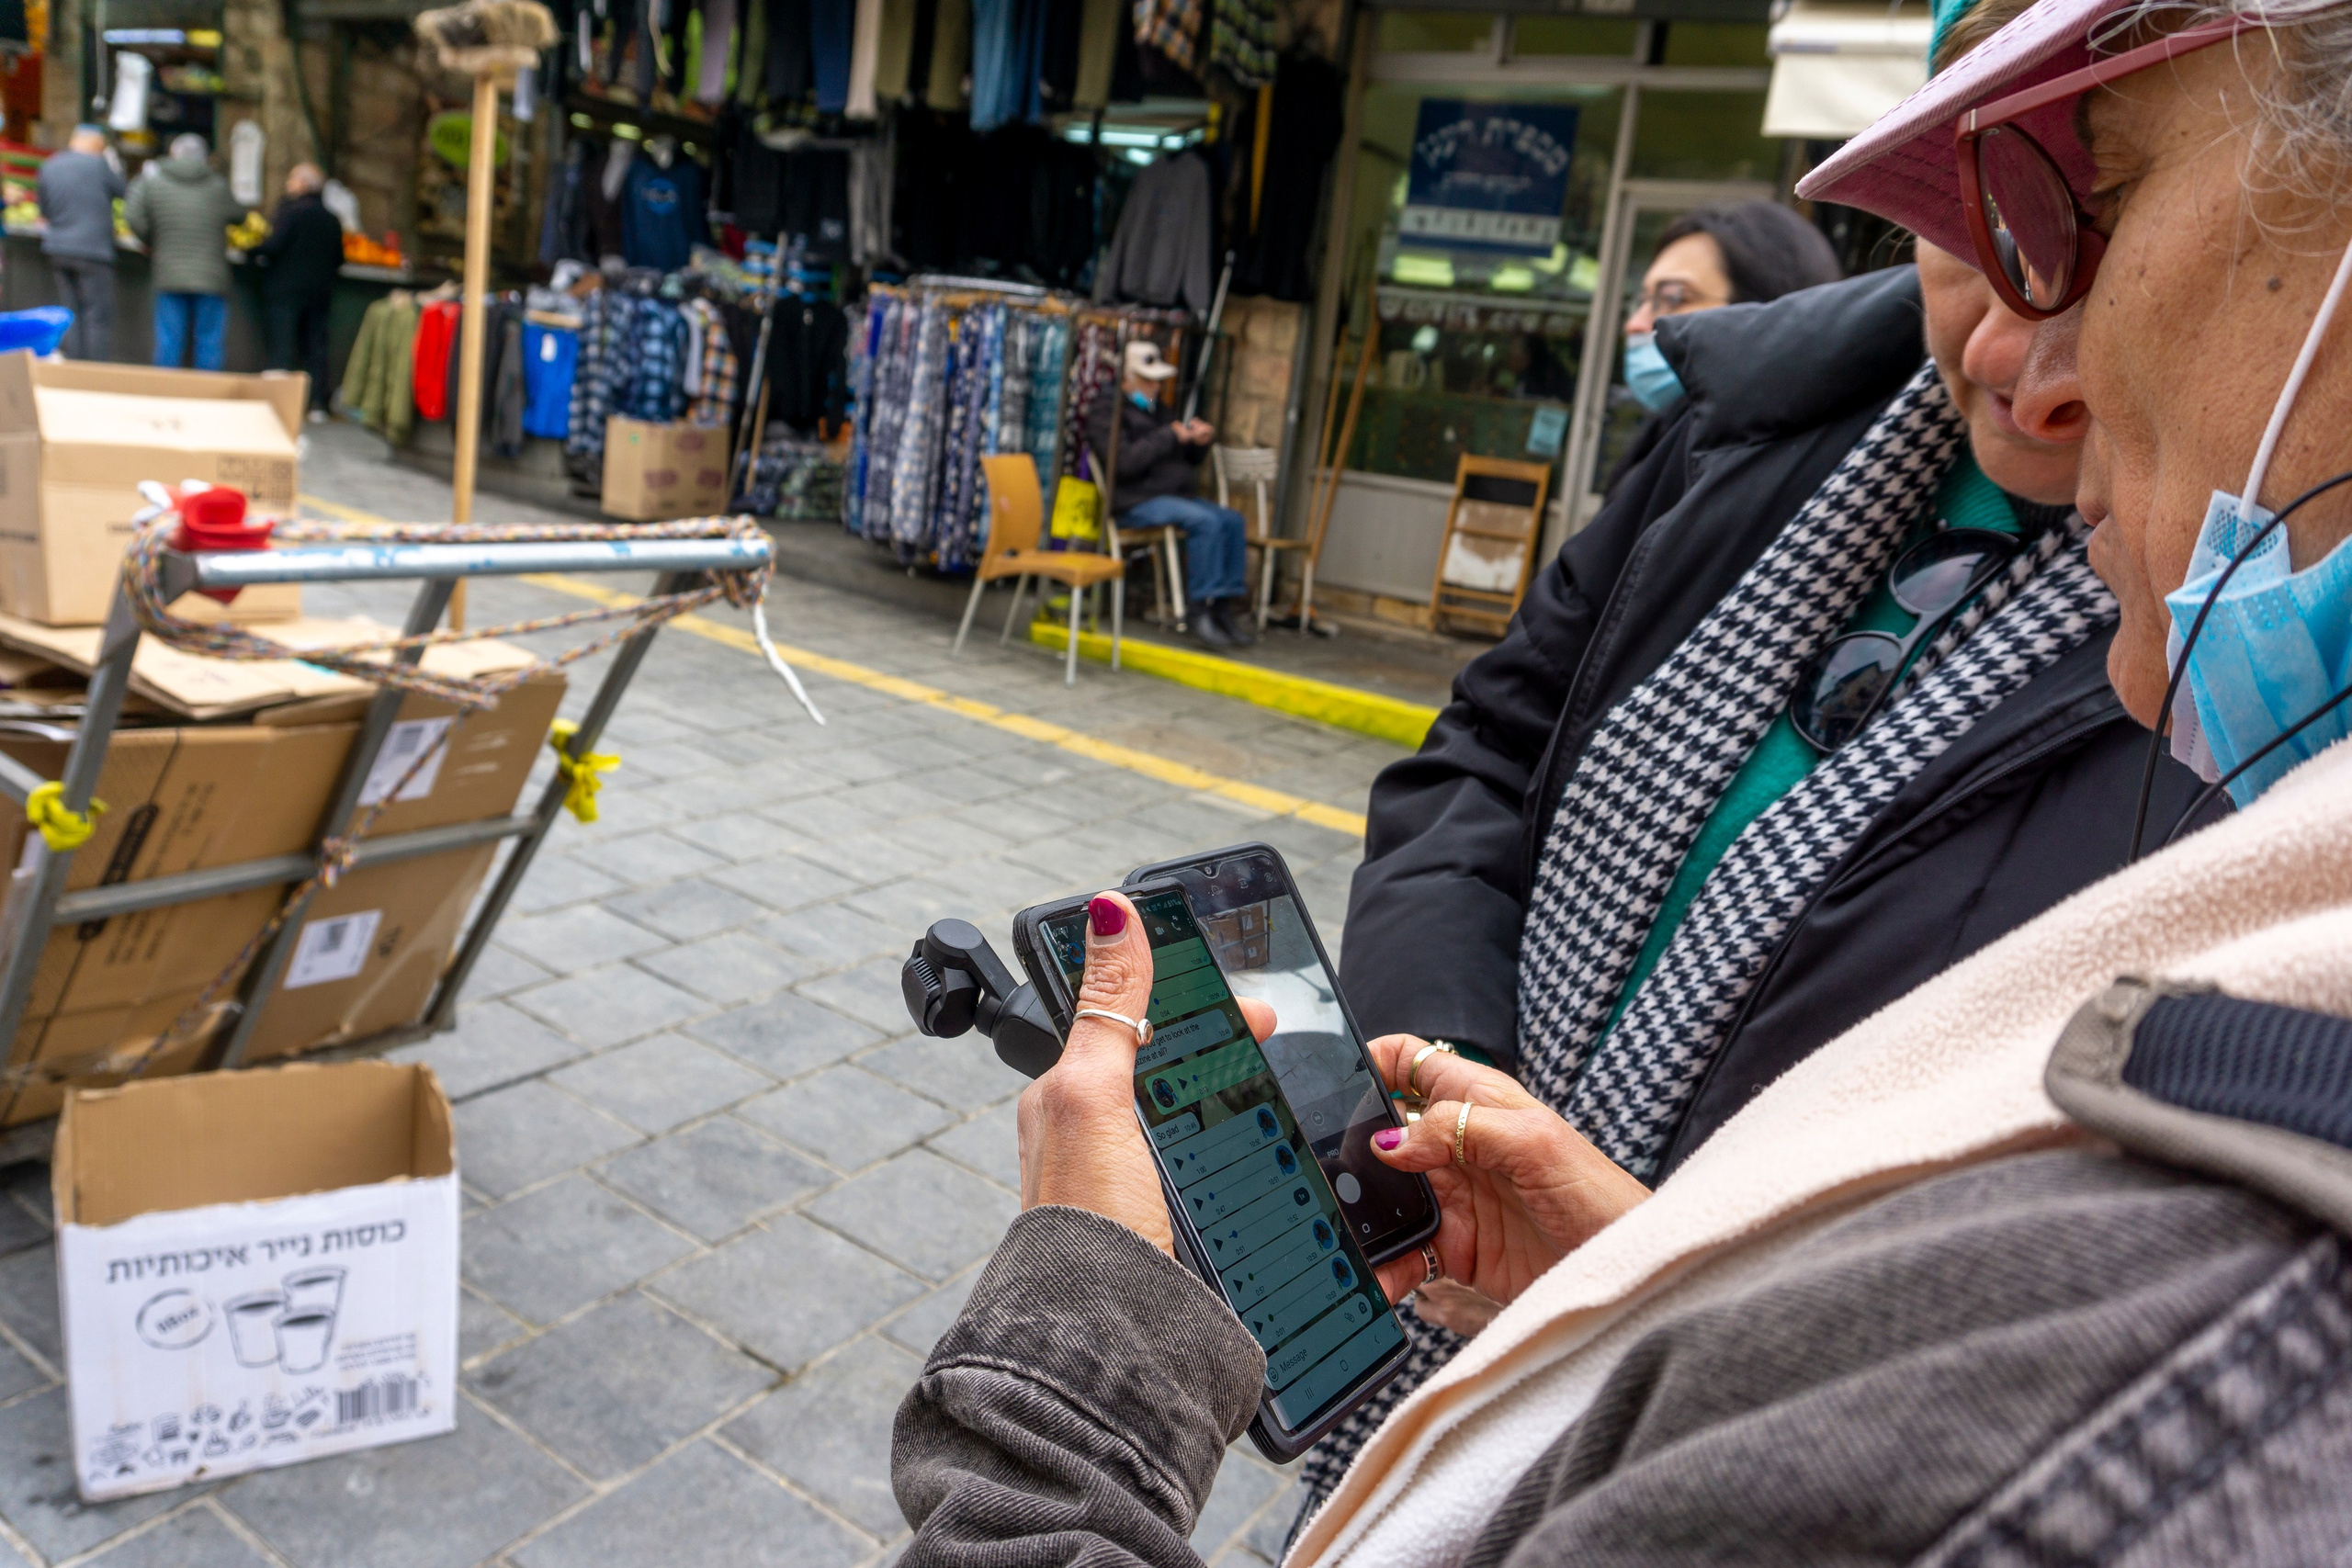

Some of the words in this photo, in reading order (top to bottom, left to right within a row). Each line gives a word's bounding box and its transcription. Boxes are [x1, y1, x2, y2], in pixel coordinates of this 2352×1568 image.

[1156, 1035, 1166, 1046] get
[1172, 1028, 1184, 1039] look
[1184, 1026, 1191, 1034] at
[1190, 1023, 1200, 1032] the
[1151, 1050, 1159, 1059] at
[1158, 1046, 1169, 1057] all?
[1156, 1131, 1166, 1141] So
[1165, 1124, 1180, 1139] glad
[1327, 1148, 1340, 1158] PRO
[1196, 1166, 1207, 1176] 1:00
[1268, 1176, 1280, 1186] 10:51
[1216, 1205, 1226, 1216] 0:47
[1287, 1213, 1299, 1224] 10:52
[321, 1219, 407, 1255] כוסות
[256, 1235, 313, 1261] נייר
[1236, 1246, 1246, 1256] 0:51
[107, 1247, 250, 1283] איכותיות
[1255, 1286, 1266, 1297] 0:57
[1275, 1326, 1285, 1337] 0:01
[1280, 1349, 1308, 1372] Message
